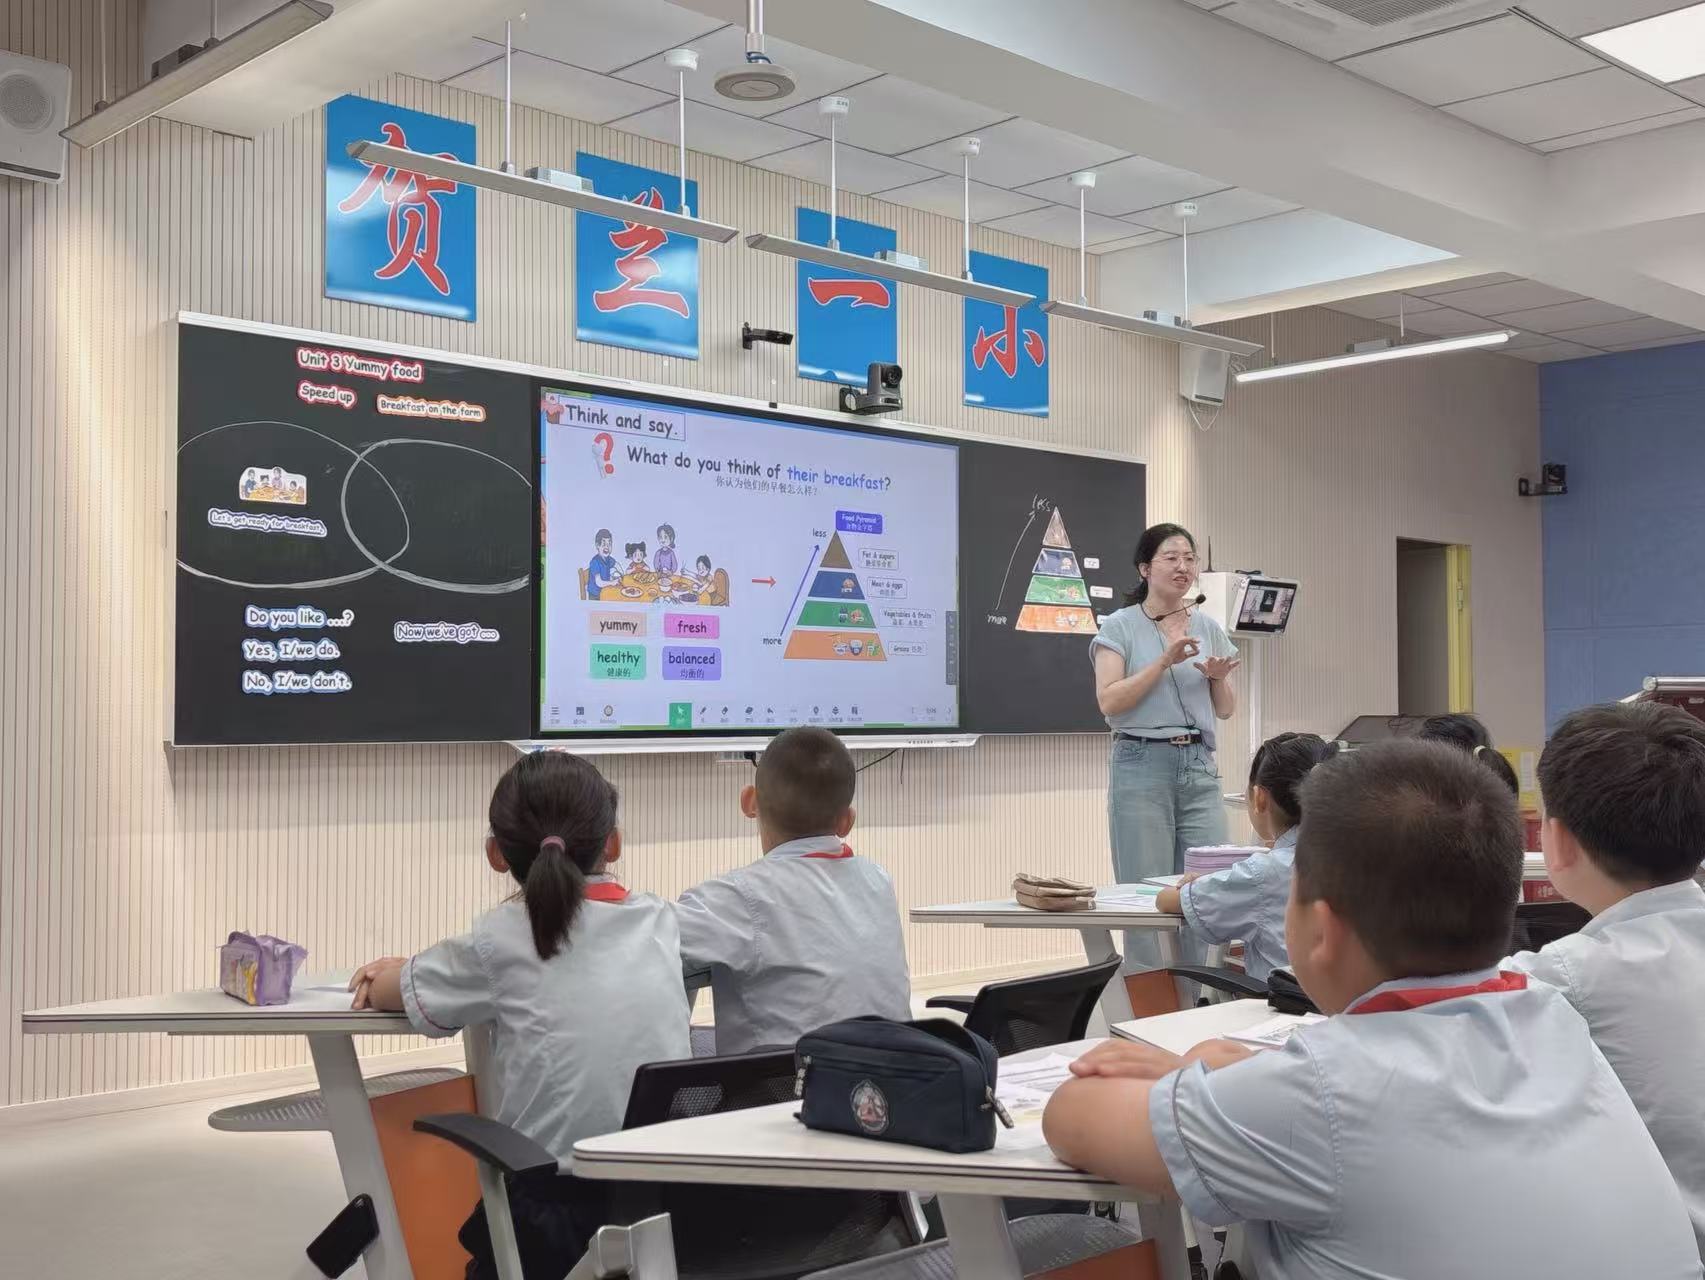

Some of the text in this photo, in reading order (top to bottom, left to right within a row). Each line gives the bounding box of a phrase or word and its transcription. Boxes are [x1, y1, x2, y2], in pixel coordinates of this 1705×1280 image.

[338, 121, 1046, 378] 贺 兰 一 小
[299, 351, 420, 380] Unit 3 Yummy food
[301, 384, 353, 406] Speed up
[380, 400, 482, 418] Breakfast on the farm
[565, 404, 679, 439] Think and say.
[626, 445, 891, 491] What do you think of their breakfast?
[213, 511, 324, 532] Let's get ready for breakfast.
[812, 528, 827, 538] less
[249, 609, 267, 622] Do
[272, 613, 295, 626] you
[300, 609, 323, 623] like
[398, 623, 423, 637] Now
[426, 623, 457, 637] we've
[459, 624, 478, 640] got
[599, 620, 639, 634] yummy
[677, 620, 708, 634] fresh
[246, 642, 339, 658] Yes, I/we do.
[763, 637, 782, 646] more
[597, 650, 640, 665] healthy
[668, 651, 716, 665] balanced
[246, 673, 351, 689] No, I/we don't.
